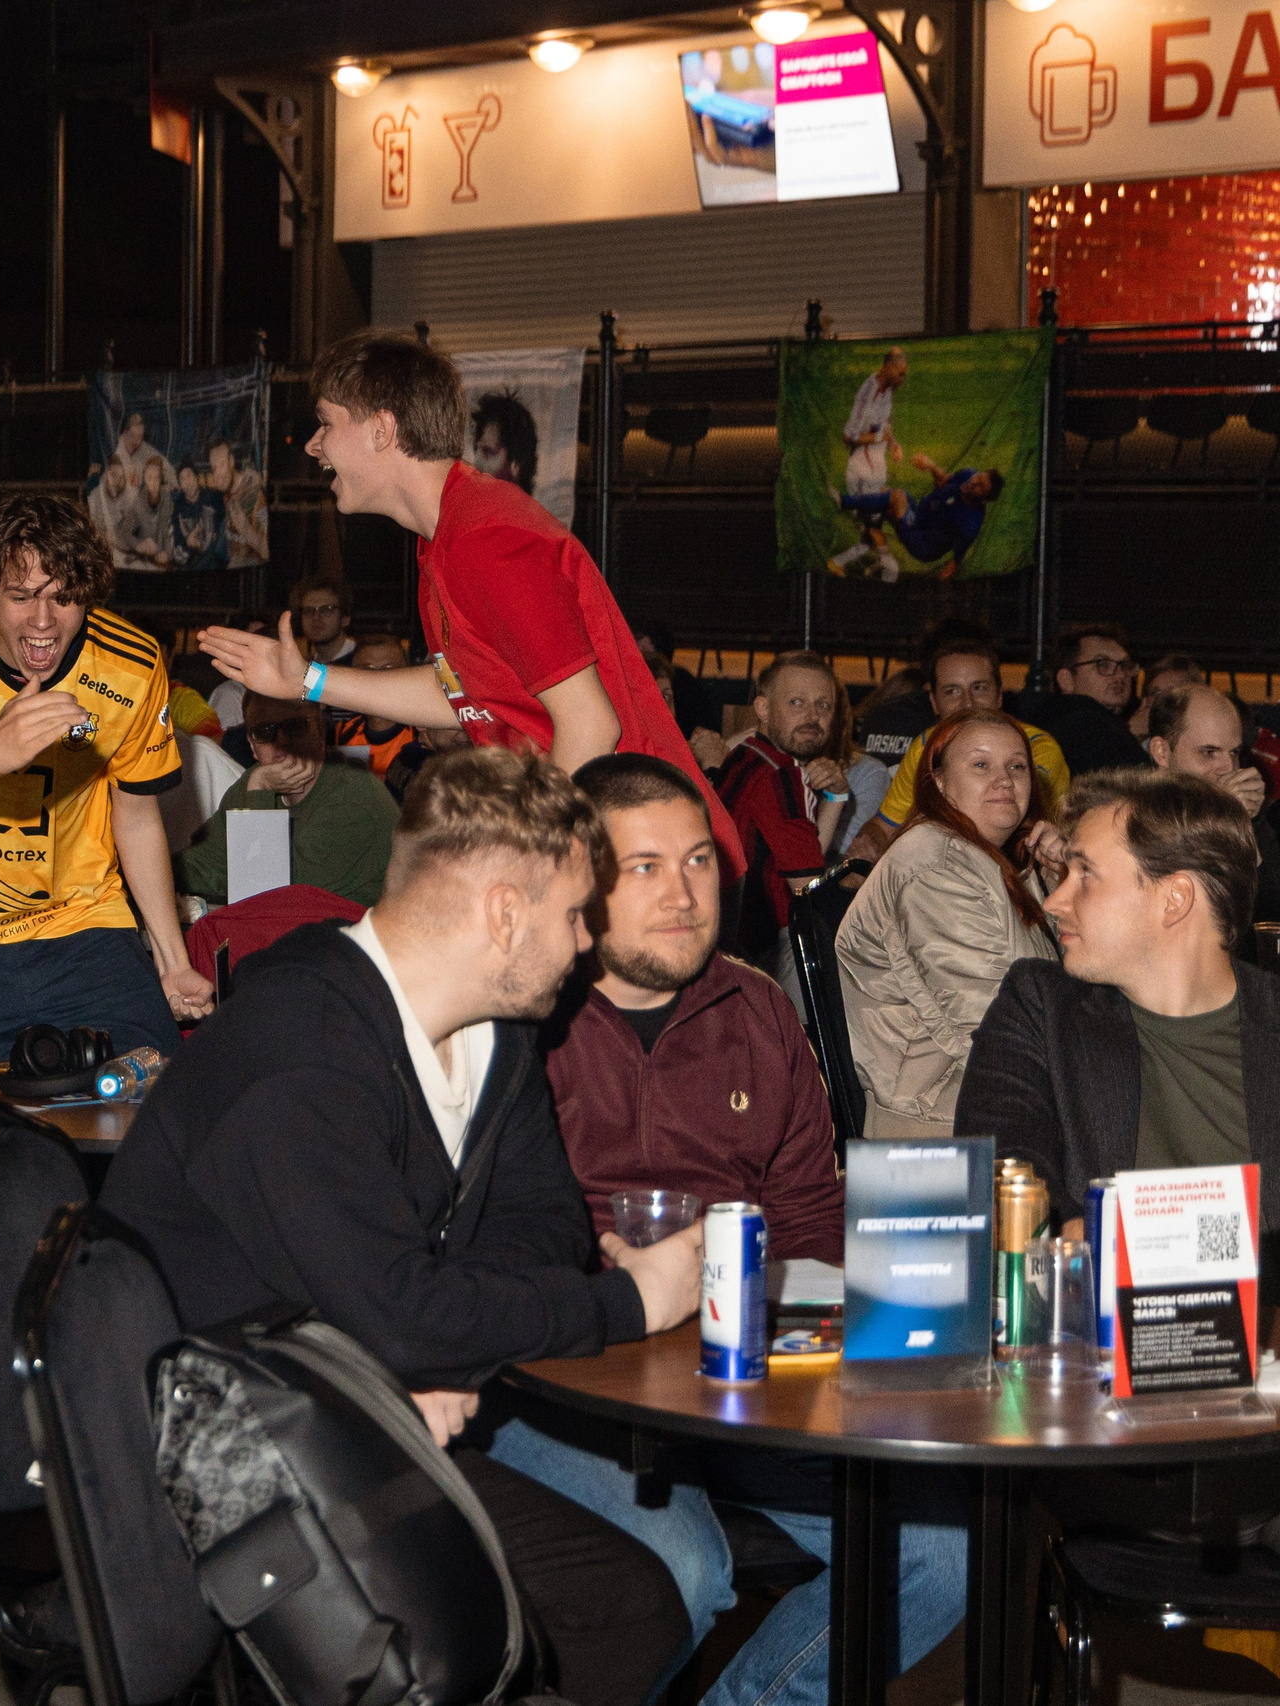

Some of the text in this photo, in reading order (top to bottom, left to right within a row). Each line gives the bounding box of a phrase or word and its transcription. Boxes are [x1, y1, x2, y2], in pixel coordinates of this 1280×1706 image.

[78, 672, 134, 709] BetBoom
[31, 913, 55, 927] ГОК
[1135, 1179, 1223, 1193] ЗАКАЗЫВАЙТЕ
[1135, 1197, 1157, 1206] ЕДУ
[1169, 1192, 1226, 1203] НАПИТКИ
[1135, 1205, 1183, 1217] ОНЛАЙН
[1132, 1291, 1232, 1308] ЧТОБЫ СДЕЛАТЬ
